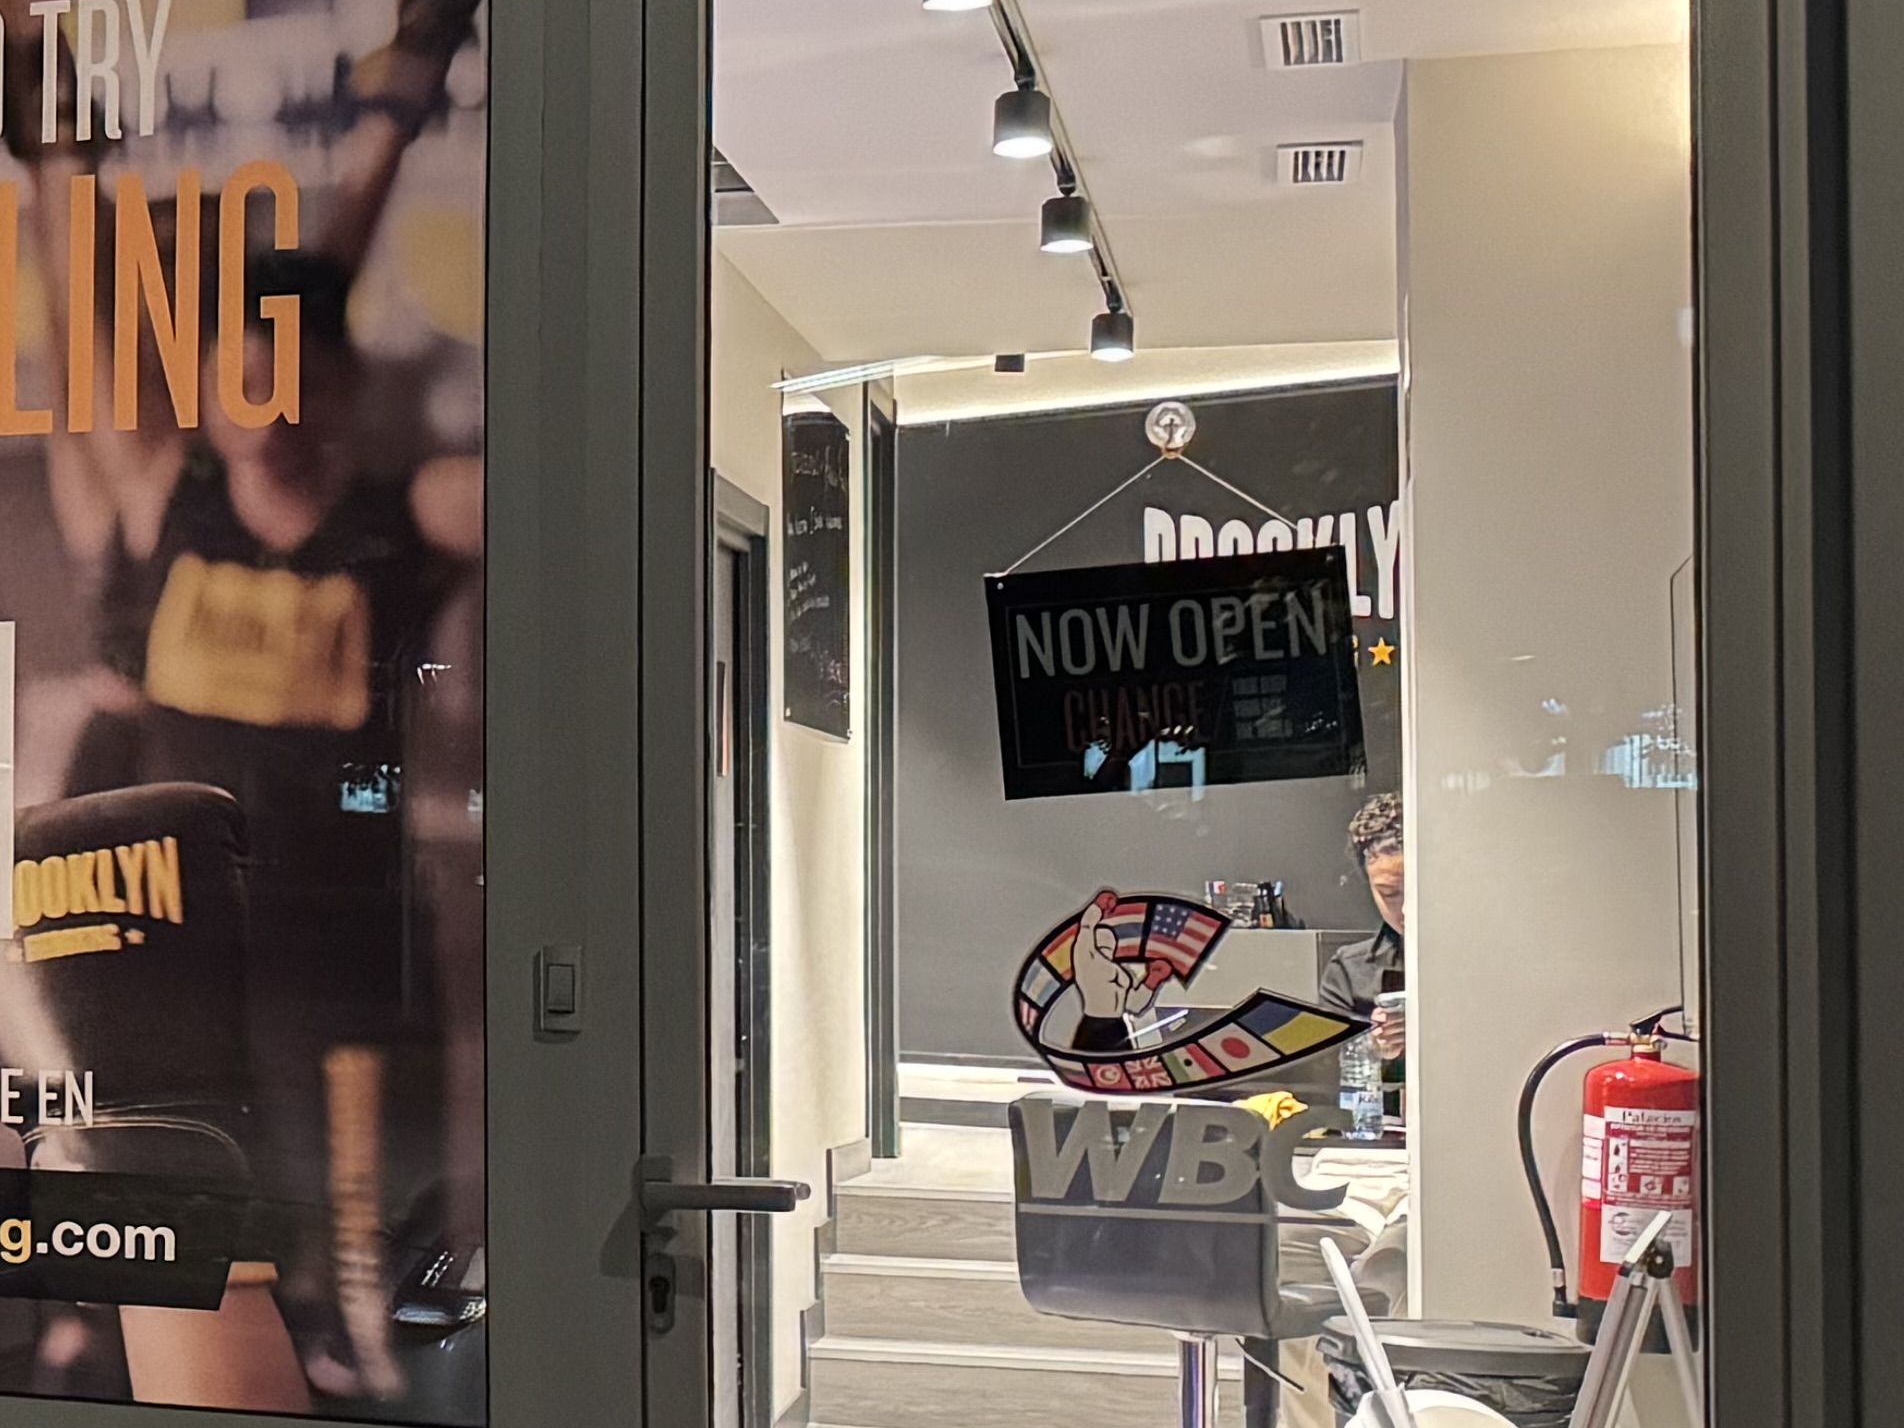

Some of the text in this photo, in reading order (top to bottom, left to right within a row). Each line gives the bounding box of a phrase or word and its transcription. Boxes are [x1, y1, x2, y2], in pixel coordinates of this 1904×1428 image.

[1015, 587, 1328, 679] NOW OPEN
[14, 835, 184, 928] OOKLYN
[38, 1069, 95, 1128] EN
[1019, 1098, 1354, 1211] WBC
